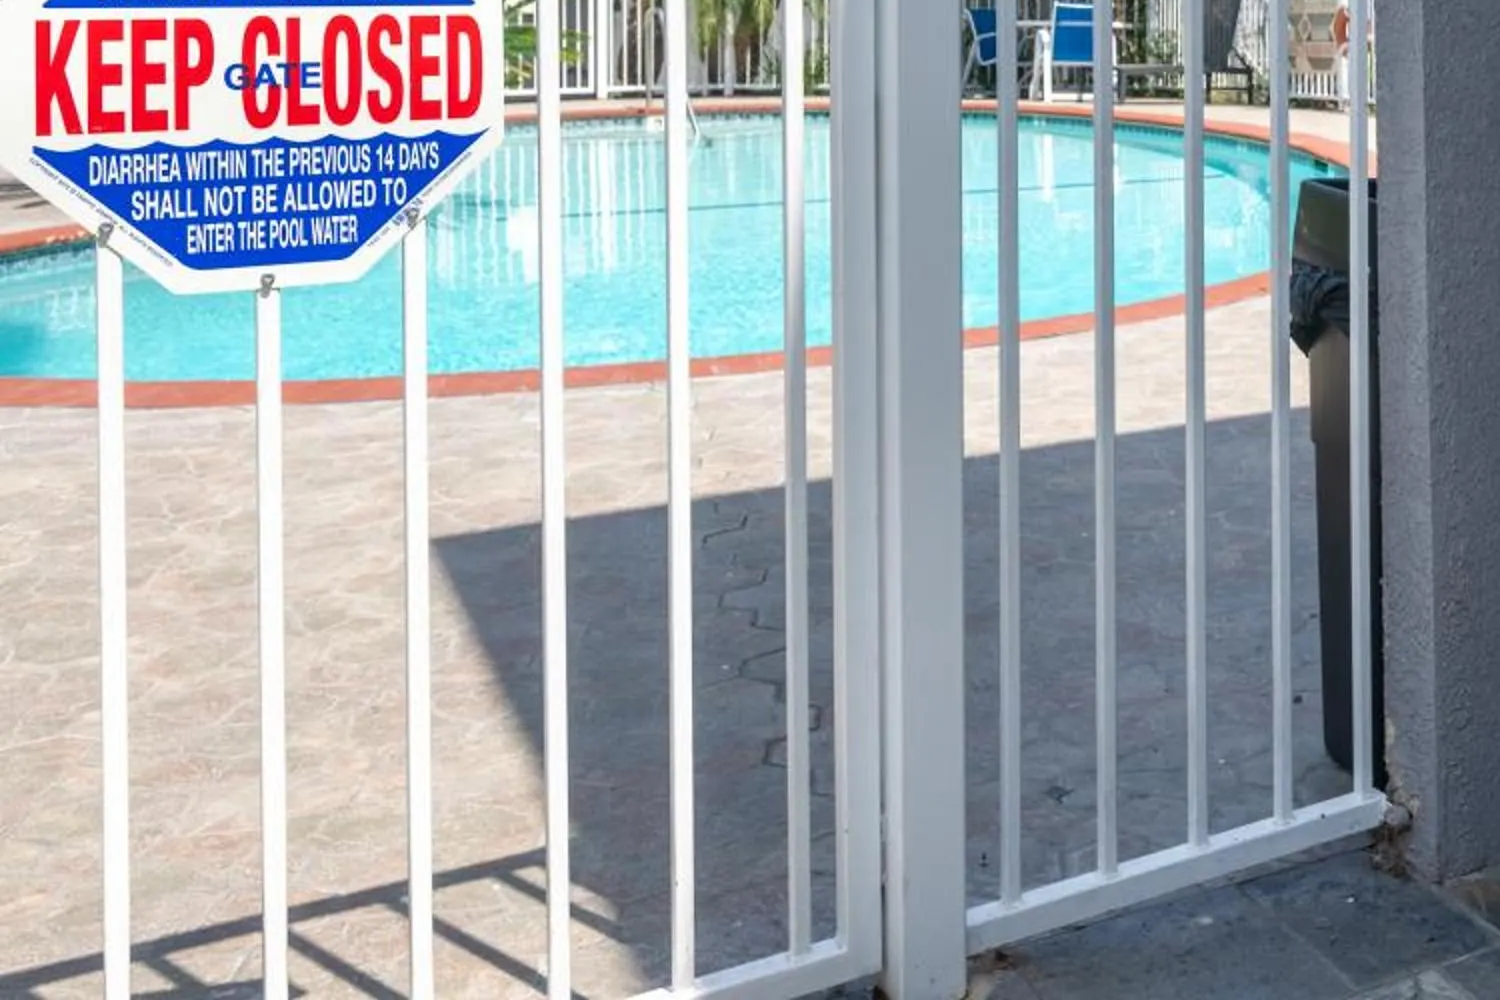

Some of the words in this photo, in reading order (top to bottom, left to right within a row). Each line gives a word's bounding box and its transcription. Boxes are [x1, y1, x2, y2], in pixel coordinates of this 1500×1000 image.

[36, 19, 214, 136] KEEP
[224, 63, 319, 89] GATE
[241, 13, 483, 129] CLOSED
[90, 153, 181, 185] DIARRHEA
[186, 150, 246, 180] WITHIN
[251, 148, 284, 177] THE
[290, 145, 370, 175] PREVIOUS
[376, 146, 394, 170] 14
[399, 142, 439, 170] DAYS
[132, 189, 198, 220] SHALL
[205, 186, 246, 216] NOT
[252, 184, 277, 213] BE
[284, 180, 376, 211] ALLOWED
[381, 177, 407, 207] TO
[188, 222, 234, 254] ENTER
[238, 220, 266, 249] THE
[270, 218, 308, 248] POOL
[312, 215, 357, 245] WATER
